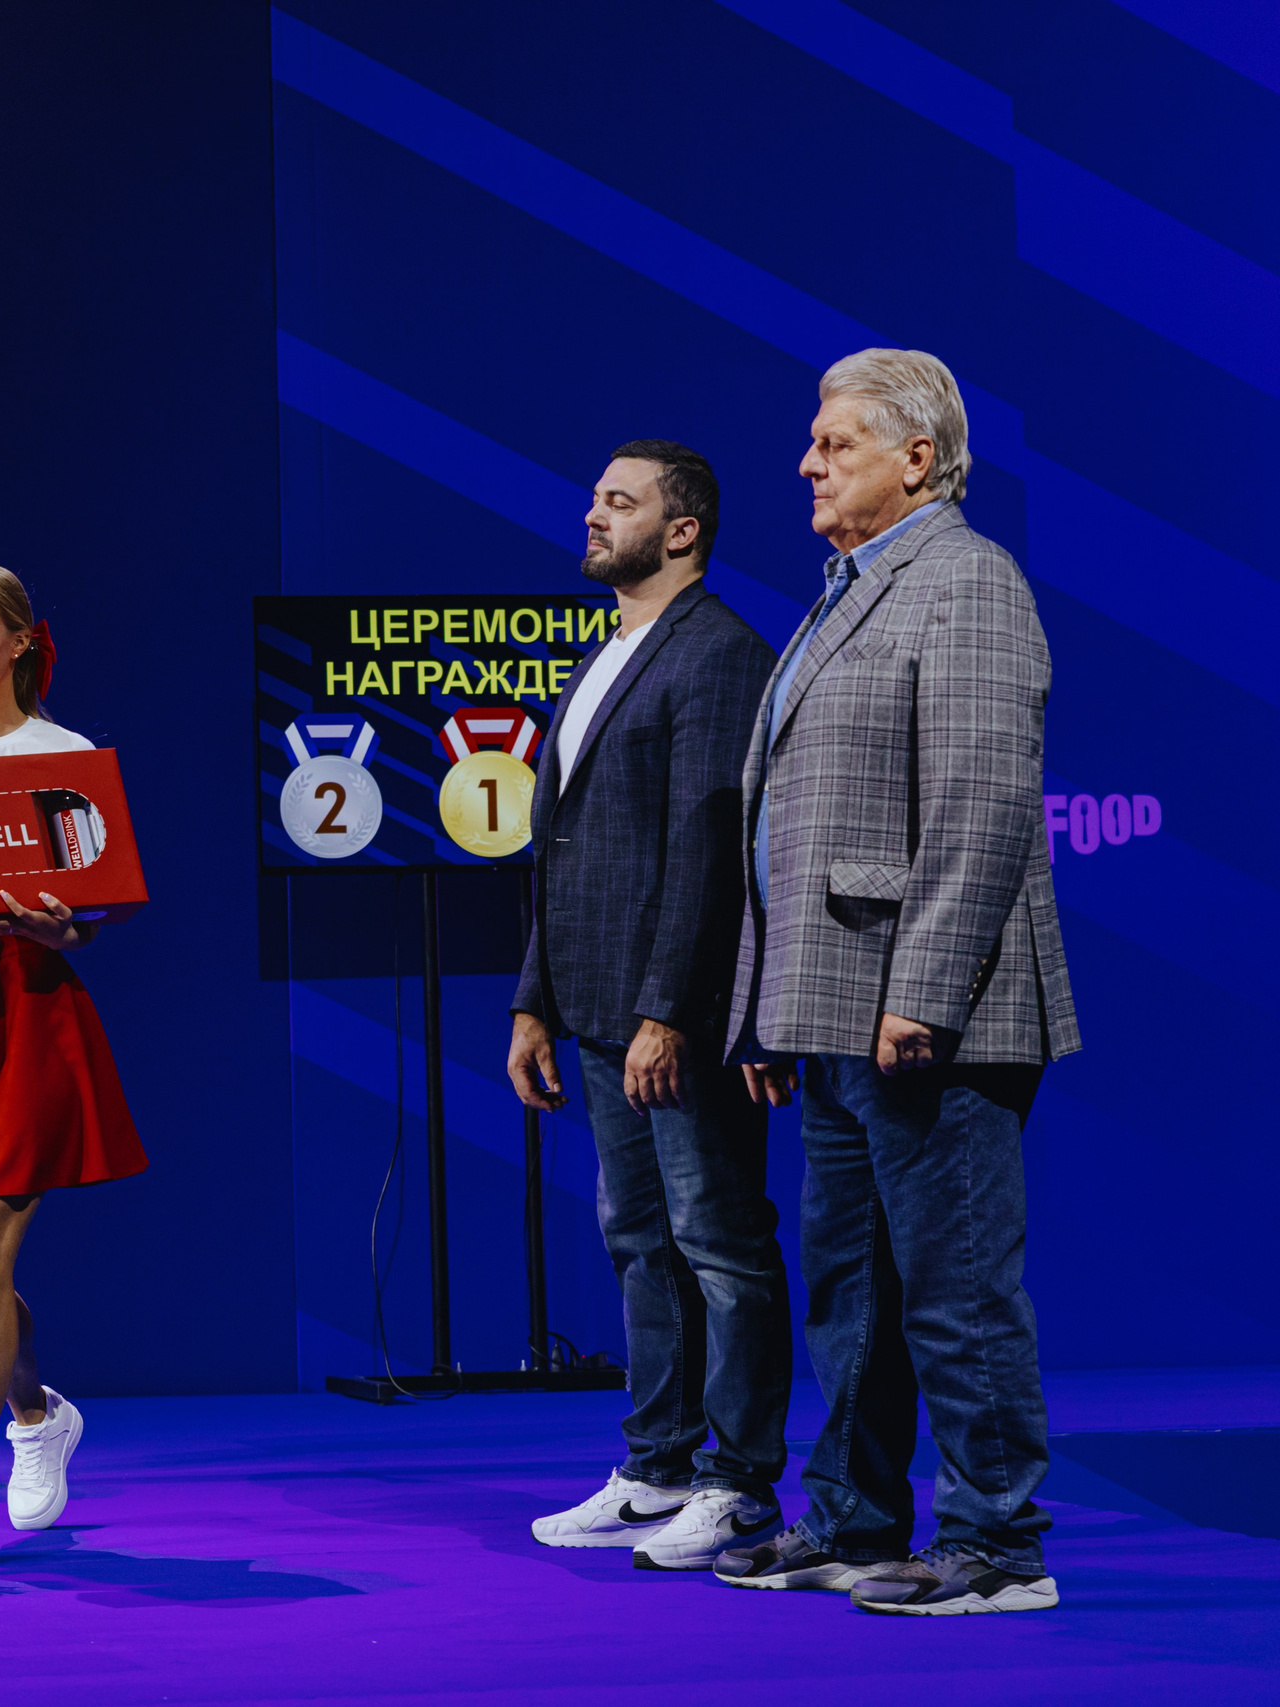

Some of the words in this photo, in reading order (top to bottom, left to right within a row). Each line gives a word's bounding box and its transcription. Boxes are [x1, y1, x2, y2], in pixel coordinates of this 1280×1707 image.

[325, 659, 583, 701] НАГРАЖДЕ
[314, 781, 348, 835] 2
[478, 778, 499, 832] 1
[62, 814, 84, 869] WELLDRINK
